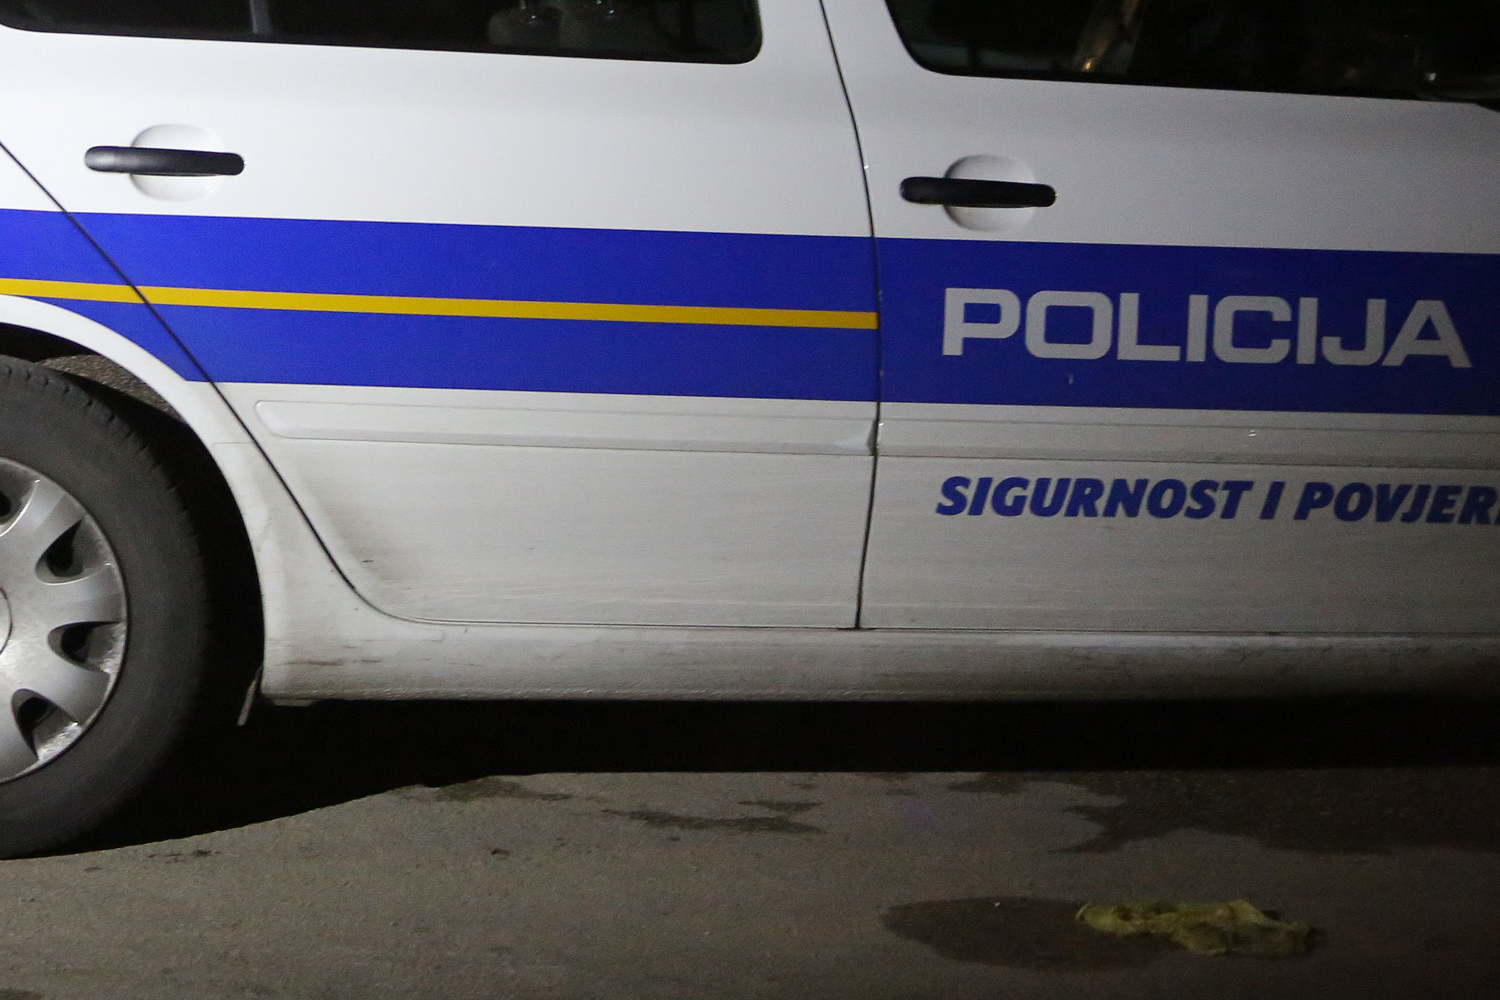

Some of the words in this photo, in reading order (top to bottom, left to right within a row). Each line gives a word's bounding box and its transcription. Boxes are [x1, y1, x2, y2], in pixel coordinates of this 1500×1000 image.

[942, 287, 1473, 368] POLICIJA
[935, 476, 1254, 520] SIGURNOST
[1259, 481, 1285, 520] I
[1293, 482, 1500, 525] POVJER
